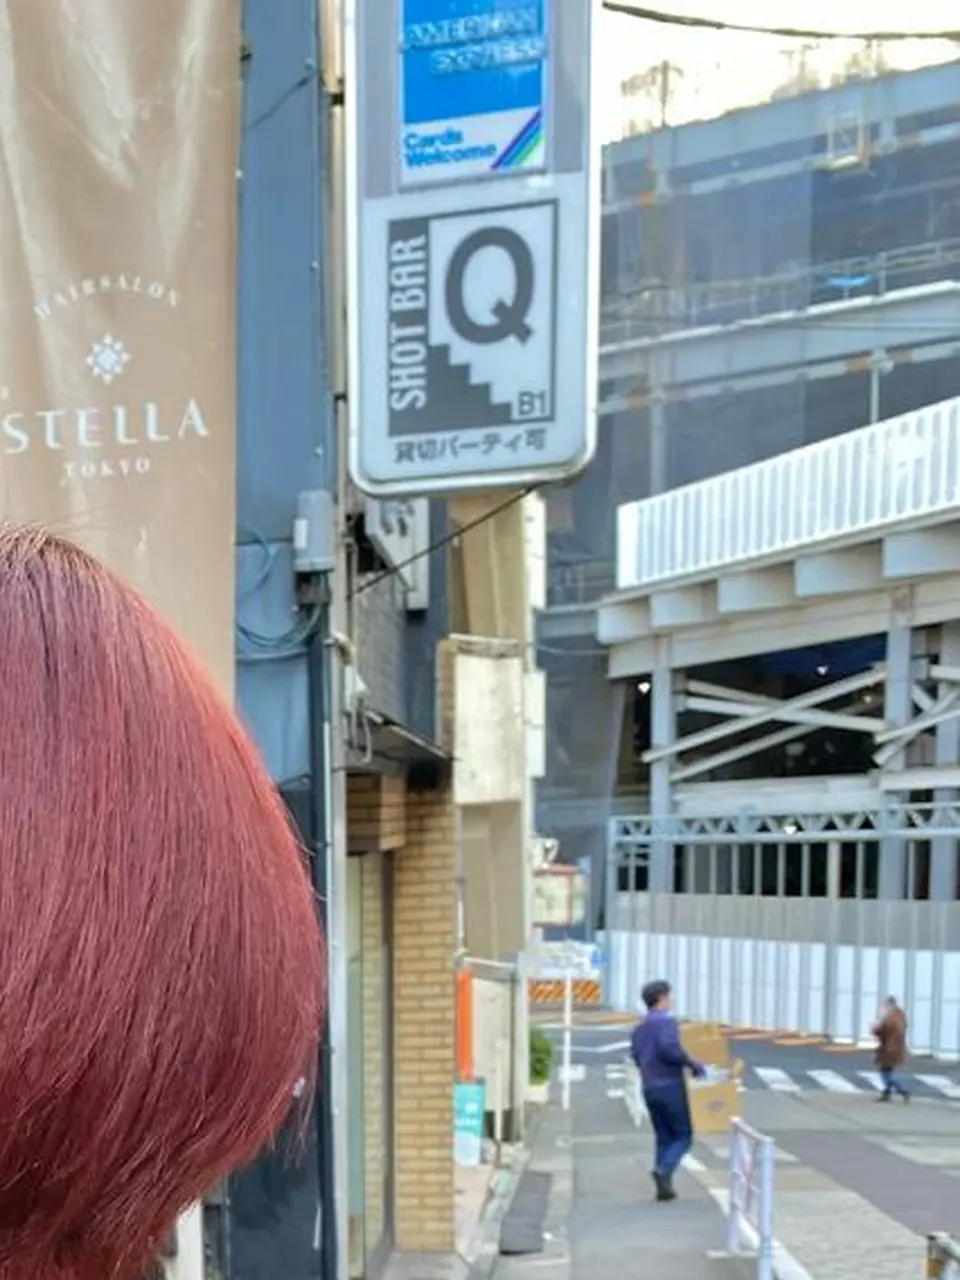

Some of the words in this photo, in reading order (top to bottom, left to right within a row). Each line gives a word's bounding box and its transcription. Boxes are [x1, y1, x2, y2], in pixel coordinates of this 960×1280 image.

[404, 126, 464, 149] Cards
[389, 233, 428, 312] BAR
[445, 226, 535, 345] Q
[389, 320, 427, 412] SHOT
[1, 397, 211, 454] STELLA
[517, 389, 549, 416] B1
[62, 454, 151, 479] TOKYO
